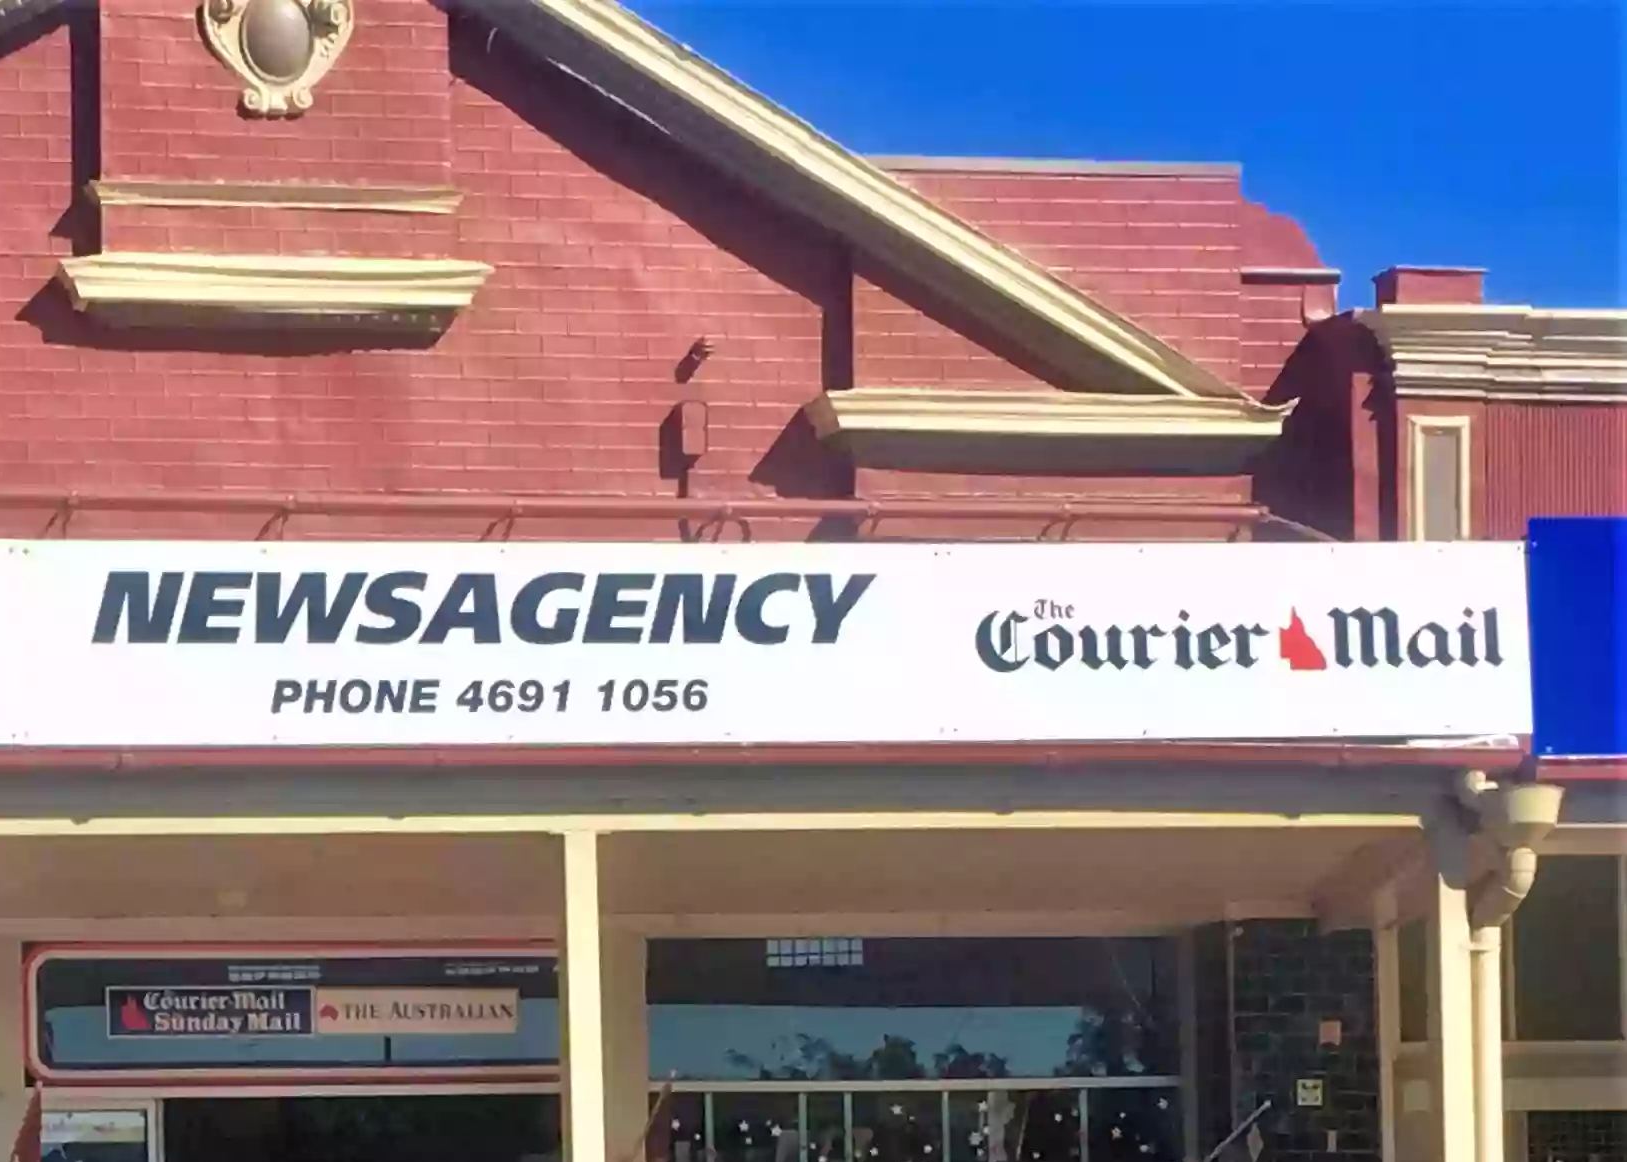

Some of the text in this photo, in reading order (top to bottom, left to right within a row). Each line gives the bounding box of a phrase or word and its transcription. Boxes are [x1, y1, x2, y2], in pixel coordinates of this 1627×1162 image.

[92, 571, 876, 645] NEWSAGENCY
[1033, 599, 1075, 620] The
[975, 606, 1504, 672] Courier Mail
[271, 679, 709, 714] PHONE 4691 1056
[154, 1012, 301, 1033] Sunday Mail
[389, 1001, 516, 1021] AUSTRALIAN
